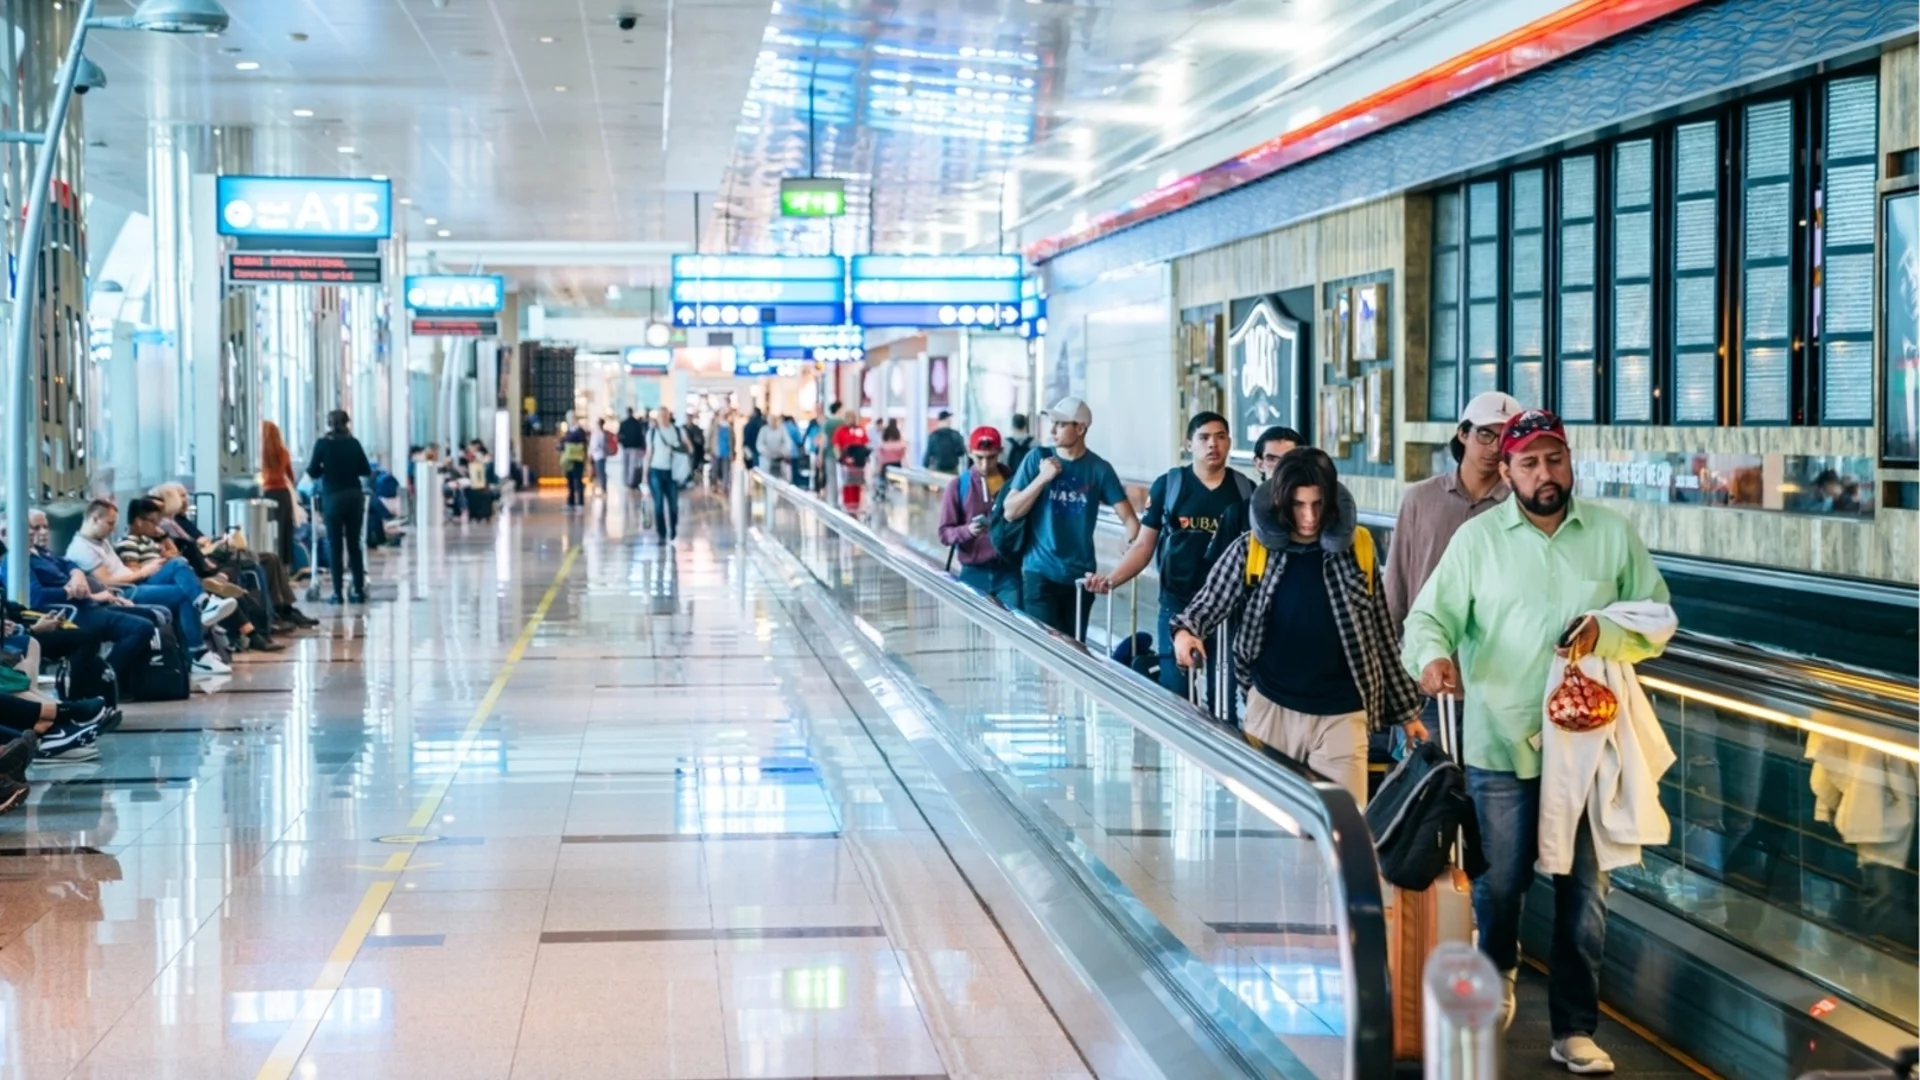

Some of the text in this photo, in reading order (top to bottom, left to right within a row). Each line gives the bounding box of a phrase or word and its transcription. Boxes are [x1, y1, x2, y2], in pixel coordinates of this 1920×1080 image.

[294, 192, 379, 232] A15
[300, 270, 318, 280] the
[447, 283, 498, 308] A14
[1049, 489, 1087, 503] NASA
[1179, 516, 1220, 530] DUBA
